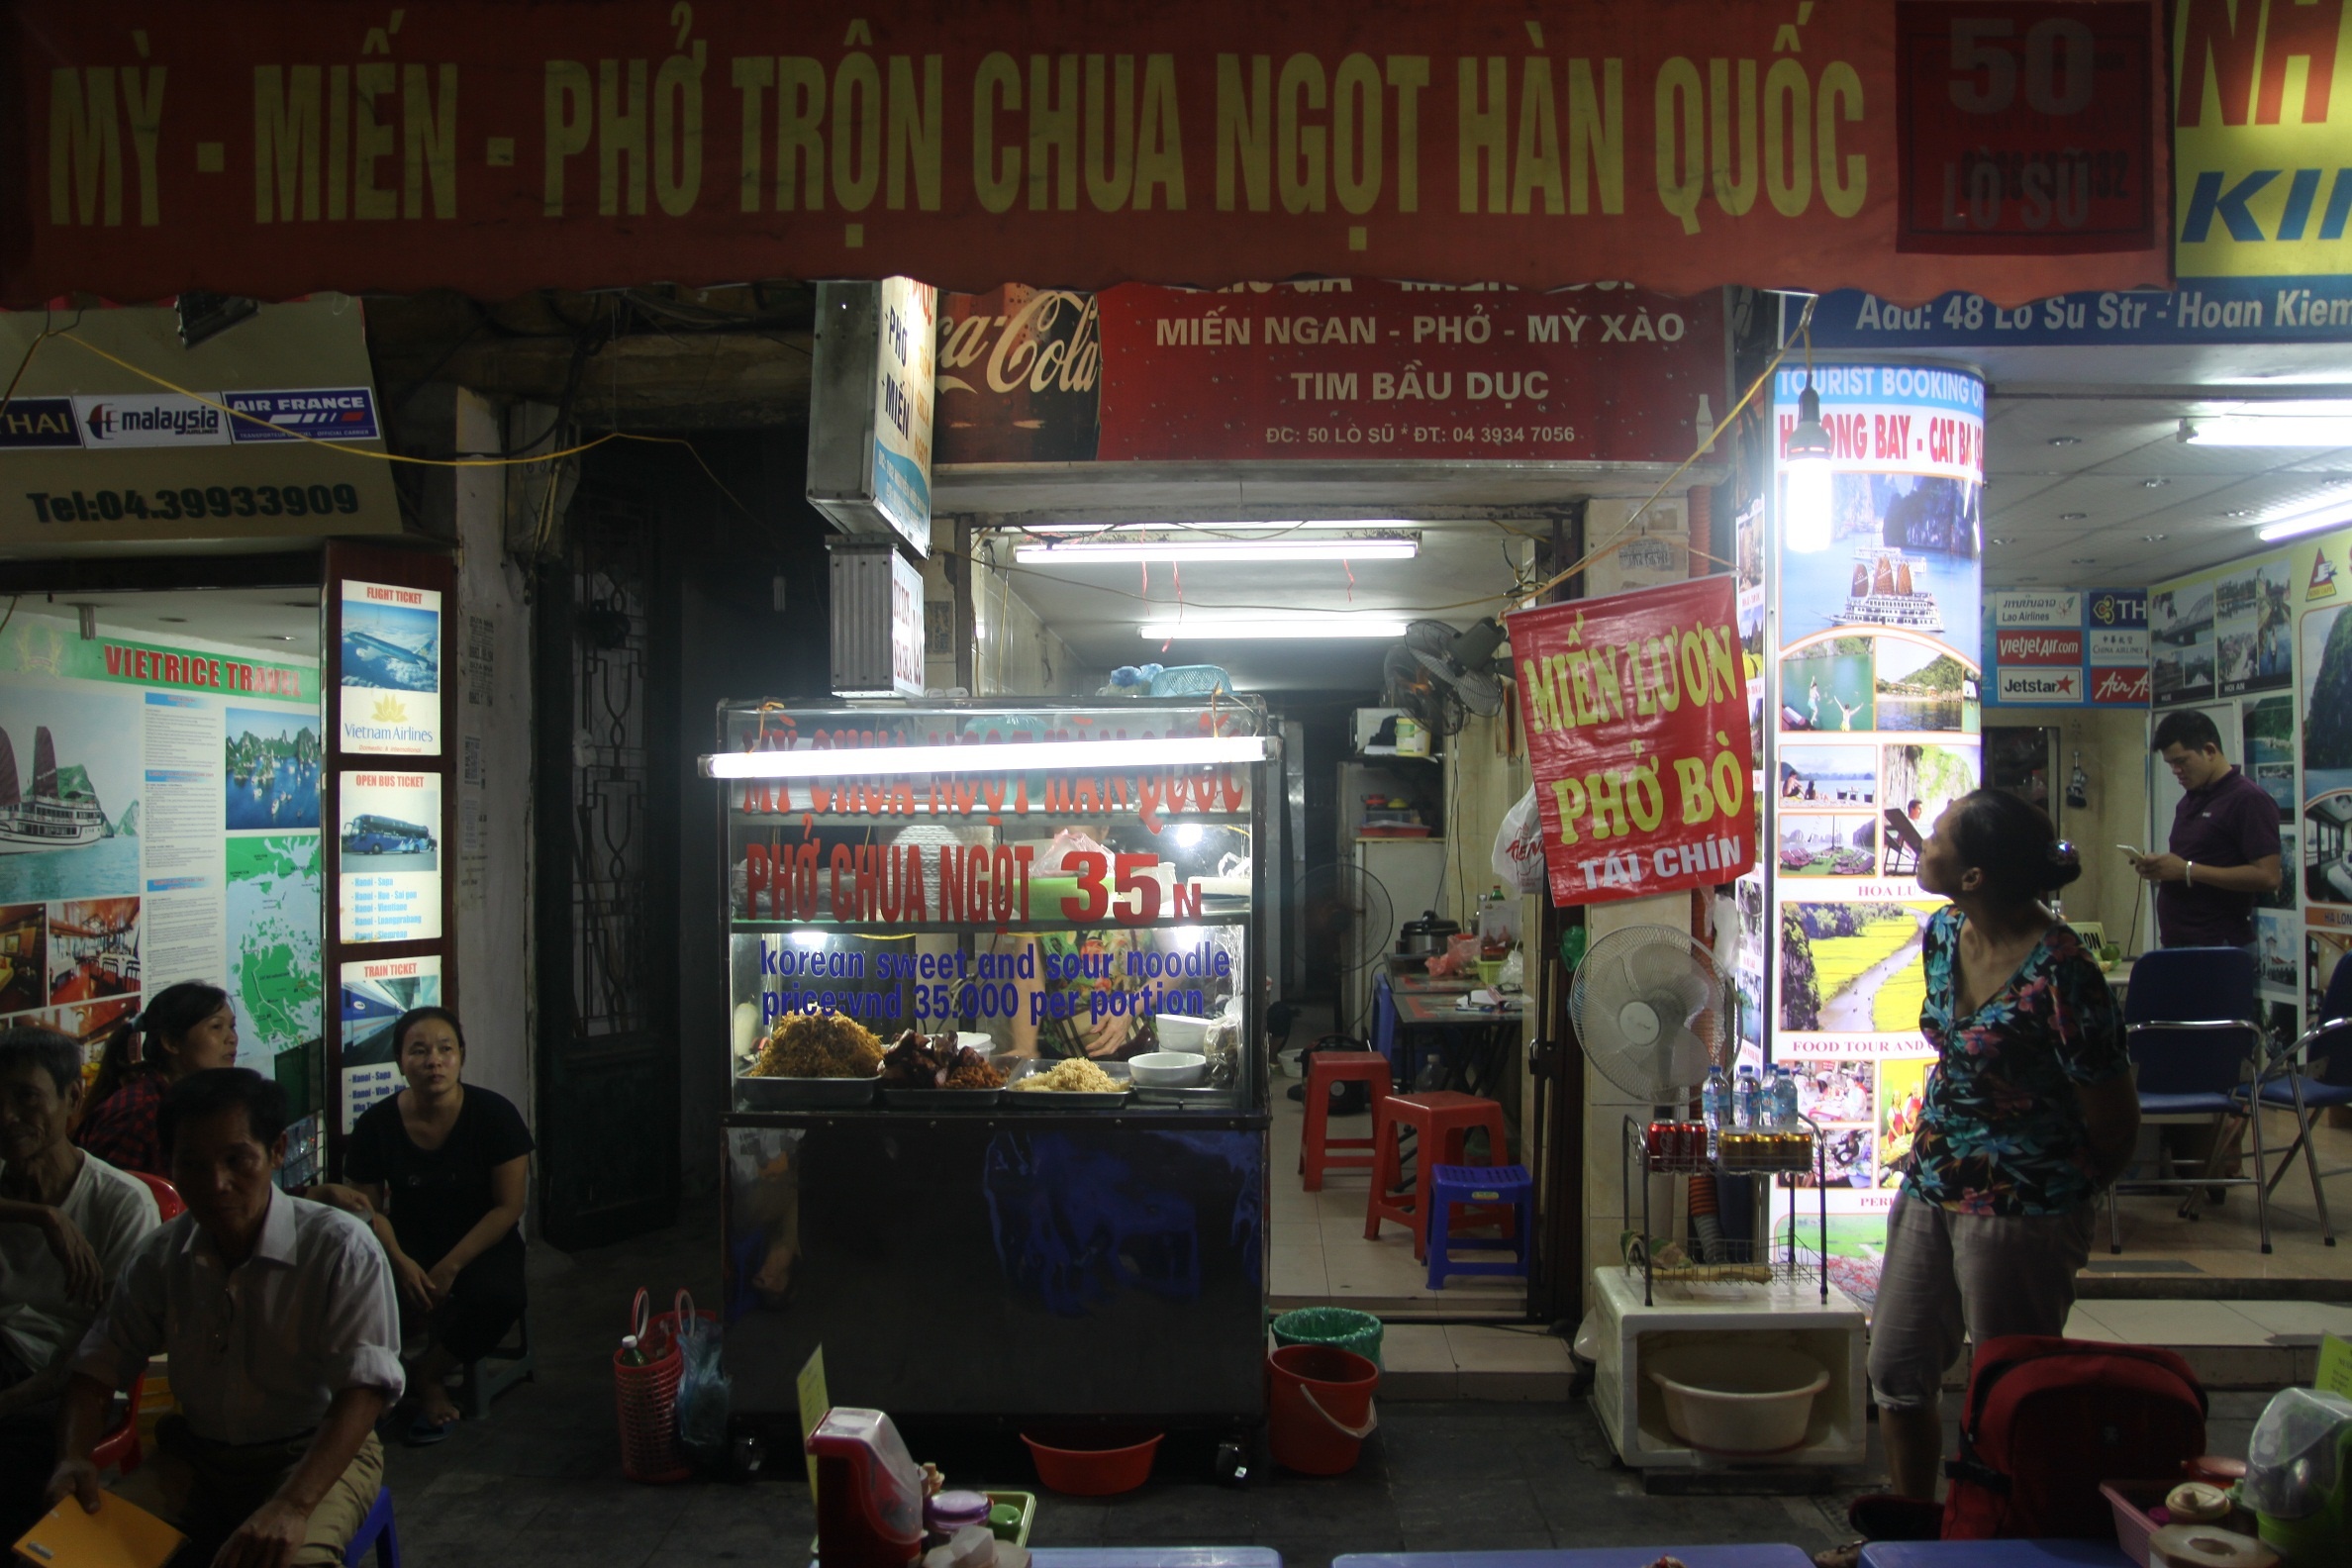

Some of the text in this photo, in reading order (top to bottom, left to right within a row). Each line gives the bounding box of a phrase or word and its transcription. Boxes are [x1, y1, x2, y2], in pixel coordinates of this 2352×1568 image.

[1948, 17, 2094, 117] 50
[49, 30, 167, 227] MỲ
[254, 8, 457, 224] MIẾN
[543, 1, 707, 217] PHỞ
[732, 18, 942, 247] TRỘN
[973, 51, 1186, 214] CHUA
[1216, 51, 1429, 250] NGỌT
[1458, 21, 1623, 215] HÀN
[1654, 1, 1868, 236] QUỐC
[1156, 305, 1250, 346] MIẾN
[1264, 316, 1376, 344] NGAN
[1414, 303, 1492, 343] PHỞ
[1527, 307, 1588, 343] MỲ
[1600, 306, 1685, 343] XÀO
[1942, 295, 1984, 331] 48
[2044, 295, 2086, 331] Su
[2097, 291, 2146, 330] Str
[2178, 291, 2263, 329] Hoan
[2275, 289, 2352, 327] Kiem
[1290, 358, 1549, 409] TIM BẦU DỤC
[1779, 366, 1875, 396] TOURIST
[1883, 367, 1969, 404] BOOKING
[0, 412, 71, 435] HAI
[122, 405, 219, 435] malaysia
[233, 396, 365, 413] AIR FRANCE
[885, 370, 910, 441] MIẾN
[1307, 428, 1328, 443] 50
[1335, 423, 1362, 443] LÒ
[1368, 423, 1395, 443] SŨ
[1452, 427, 1475, 442] 04
[1481, 427, 1524, 442] 3934
[1530, 427, 1575, 442] 7056
[1875, 414, 1911, 460] BAY
[1929, 417, 1955, 465] CAT
[366, 586, 423, 605] FLIGHT TICKET
[2116, 599, 2148, 621] TH
[2003, 611, 2050, 622] Lao Airlines
[105, 644, 302, 698] VIETRICE TRAVEL
[1522, 612, 1737, 735] MIẾN LƯƠN
[2005, 678, 2057, 693] Jetstar
[344, 722, 434, 742] Vietnam Airlines
[355, 774, 425, 788] OPEN BUS TICKET
[810, 729, 916, 816] CHUA
[929, 729, 1033, 828] NGỌT
[1043, 715, 1128, 815] HÀN
[1551, 730, 1743, 845] PHỞ BÒ
[746, 812, 1034, 934] PHỞ CHUA NGỌT
[1578, 842, 1641, 890] TÁI
[1653, 833, 1742, 879] CHÍN
[1060, 849, 1162, 925] 35
[1858, 885, 1916, 897] HOA LU
[2336, 913, 2352, 926] LON
[364, 962, 417, 978] TRAIN TICKET
[759, 939, 1231, 980] korean sweet and sour noodle
[913, 982, 1020, 1021] 35.000
[1029, 988, 1082, 1027] per
[1090, 985, 1205, 1026] portion
[1793, 1039, 1924, 1052] FOOD TOUR AND
